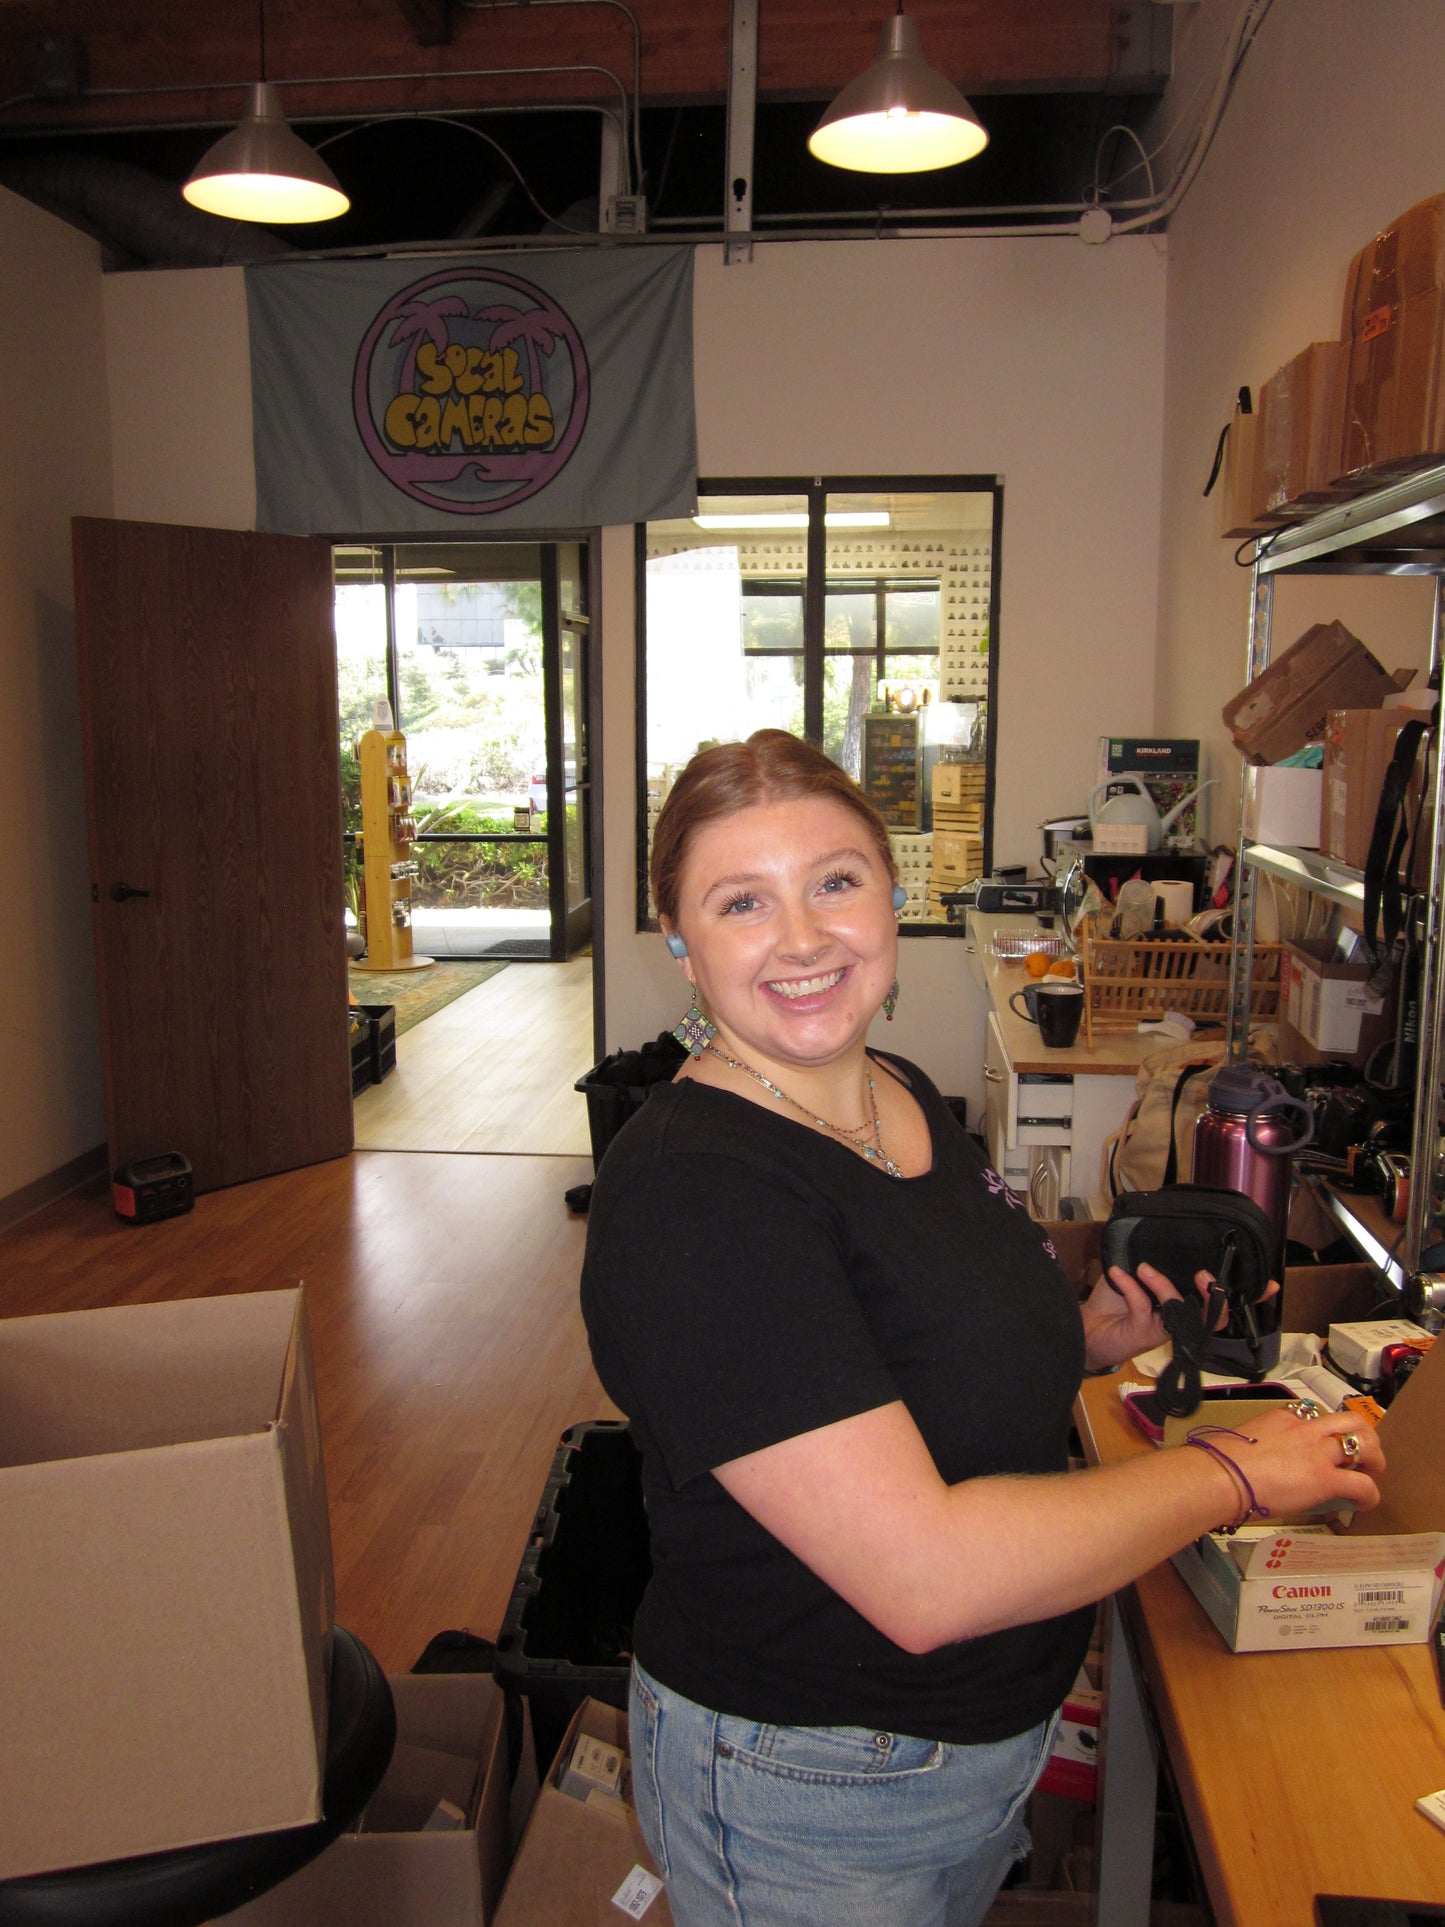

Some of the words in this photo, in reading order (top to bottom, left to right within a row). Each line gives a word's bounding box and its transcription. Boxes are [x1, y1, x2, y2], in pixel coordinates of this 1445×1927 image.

[1403, 1000, 1418, 1044] Nikon
[1272, 1584, 1332, 1599] Canon
[1257, 1604, 1298, 1615] PowerShot
[1335, 1602, 1345, 1611] IS
[1273, 1613, 1302, 1621] DIGITAL
